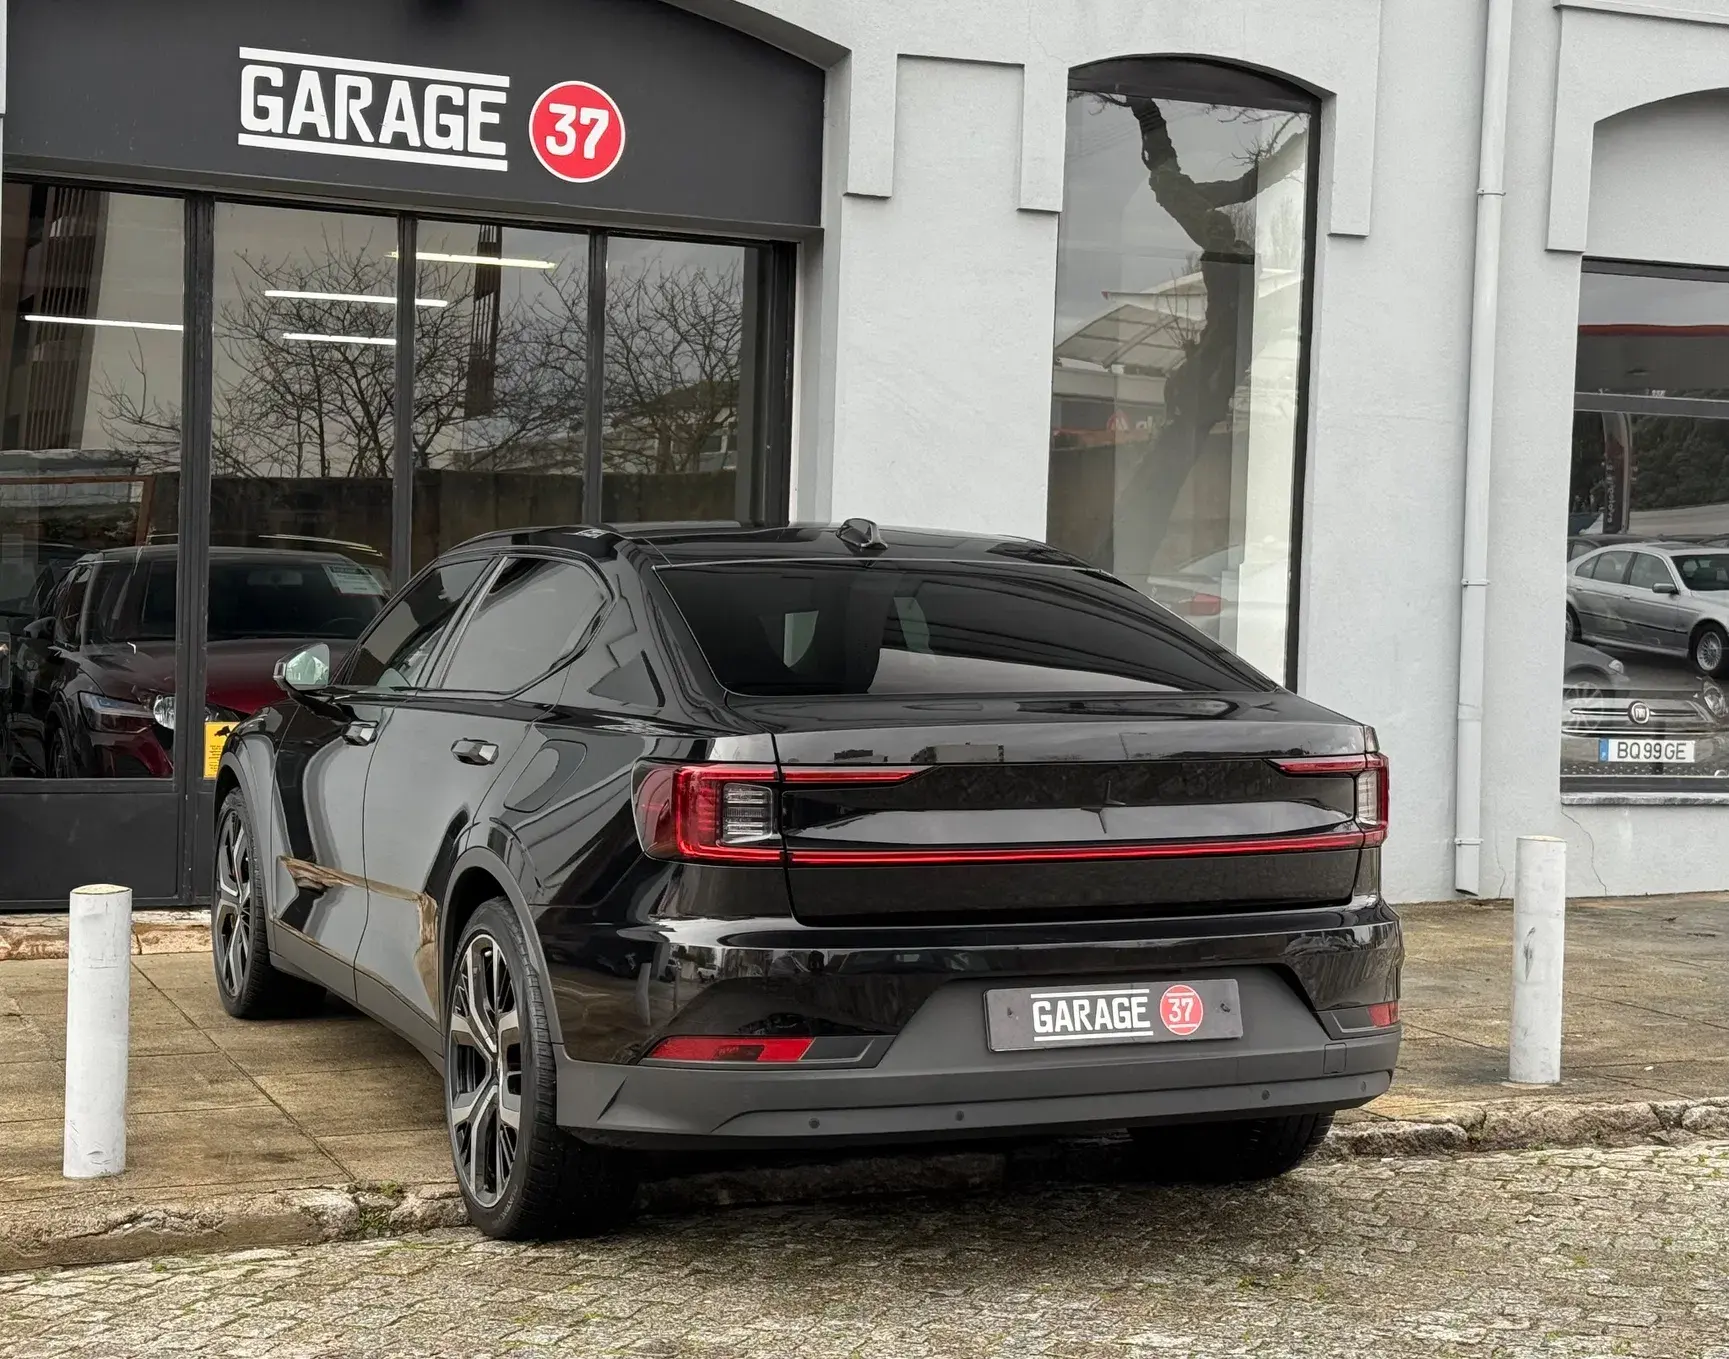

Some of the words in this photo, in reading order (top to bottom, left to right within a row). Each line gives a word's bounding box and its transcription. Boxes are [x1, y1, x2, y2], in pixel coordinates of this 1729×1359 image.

[239, 64, 508, 157] GARAGE
[545, 103, 611, 161] 37
[1031, 996, 1151, 1034] GARAGE
[1168, 998, 1195, 1023] 37
